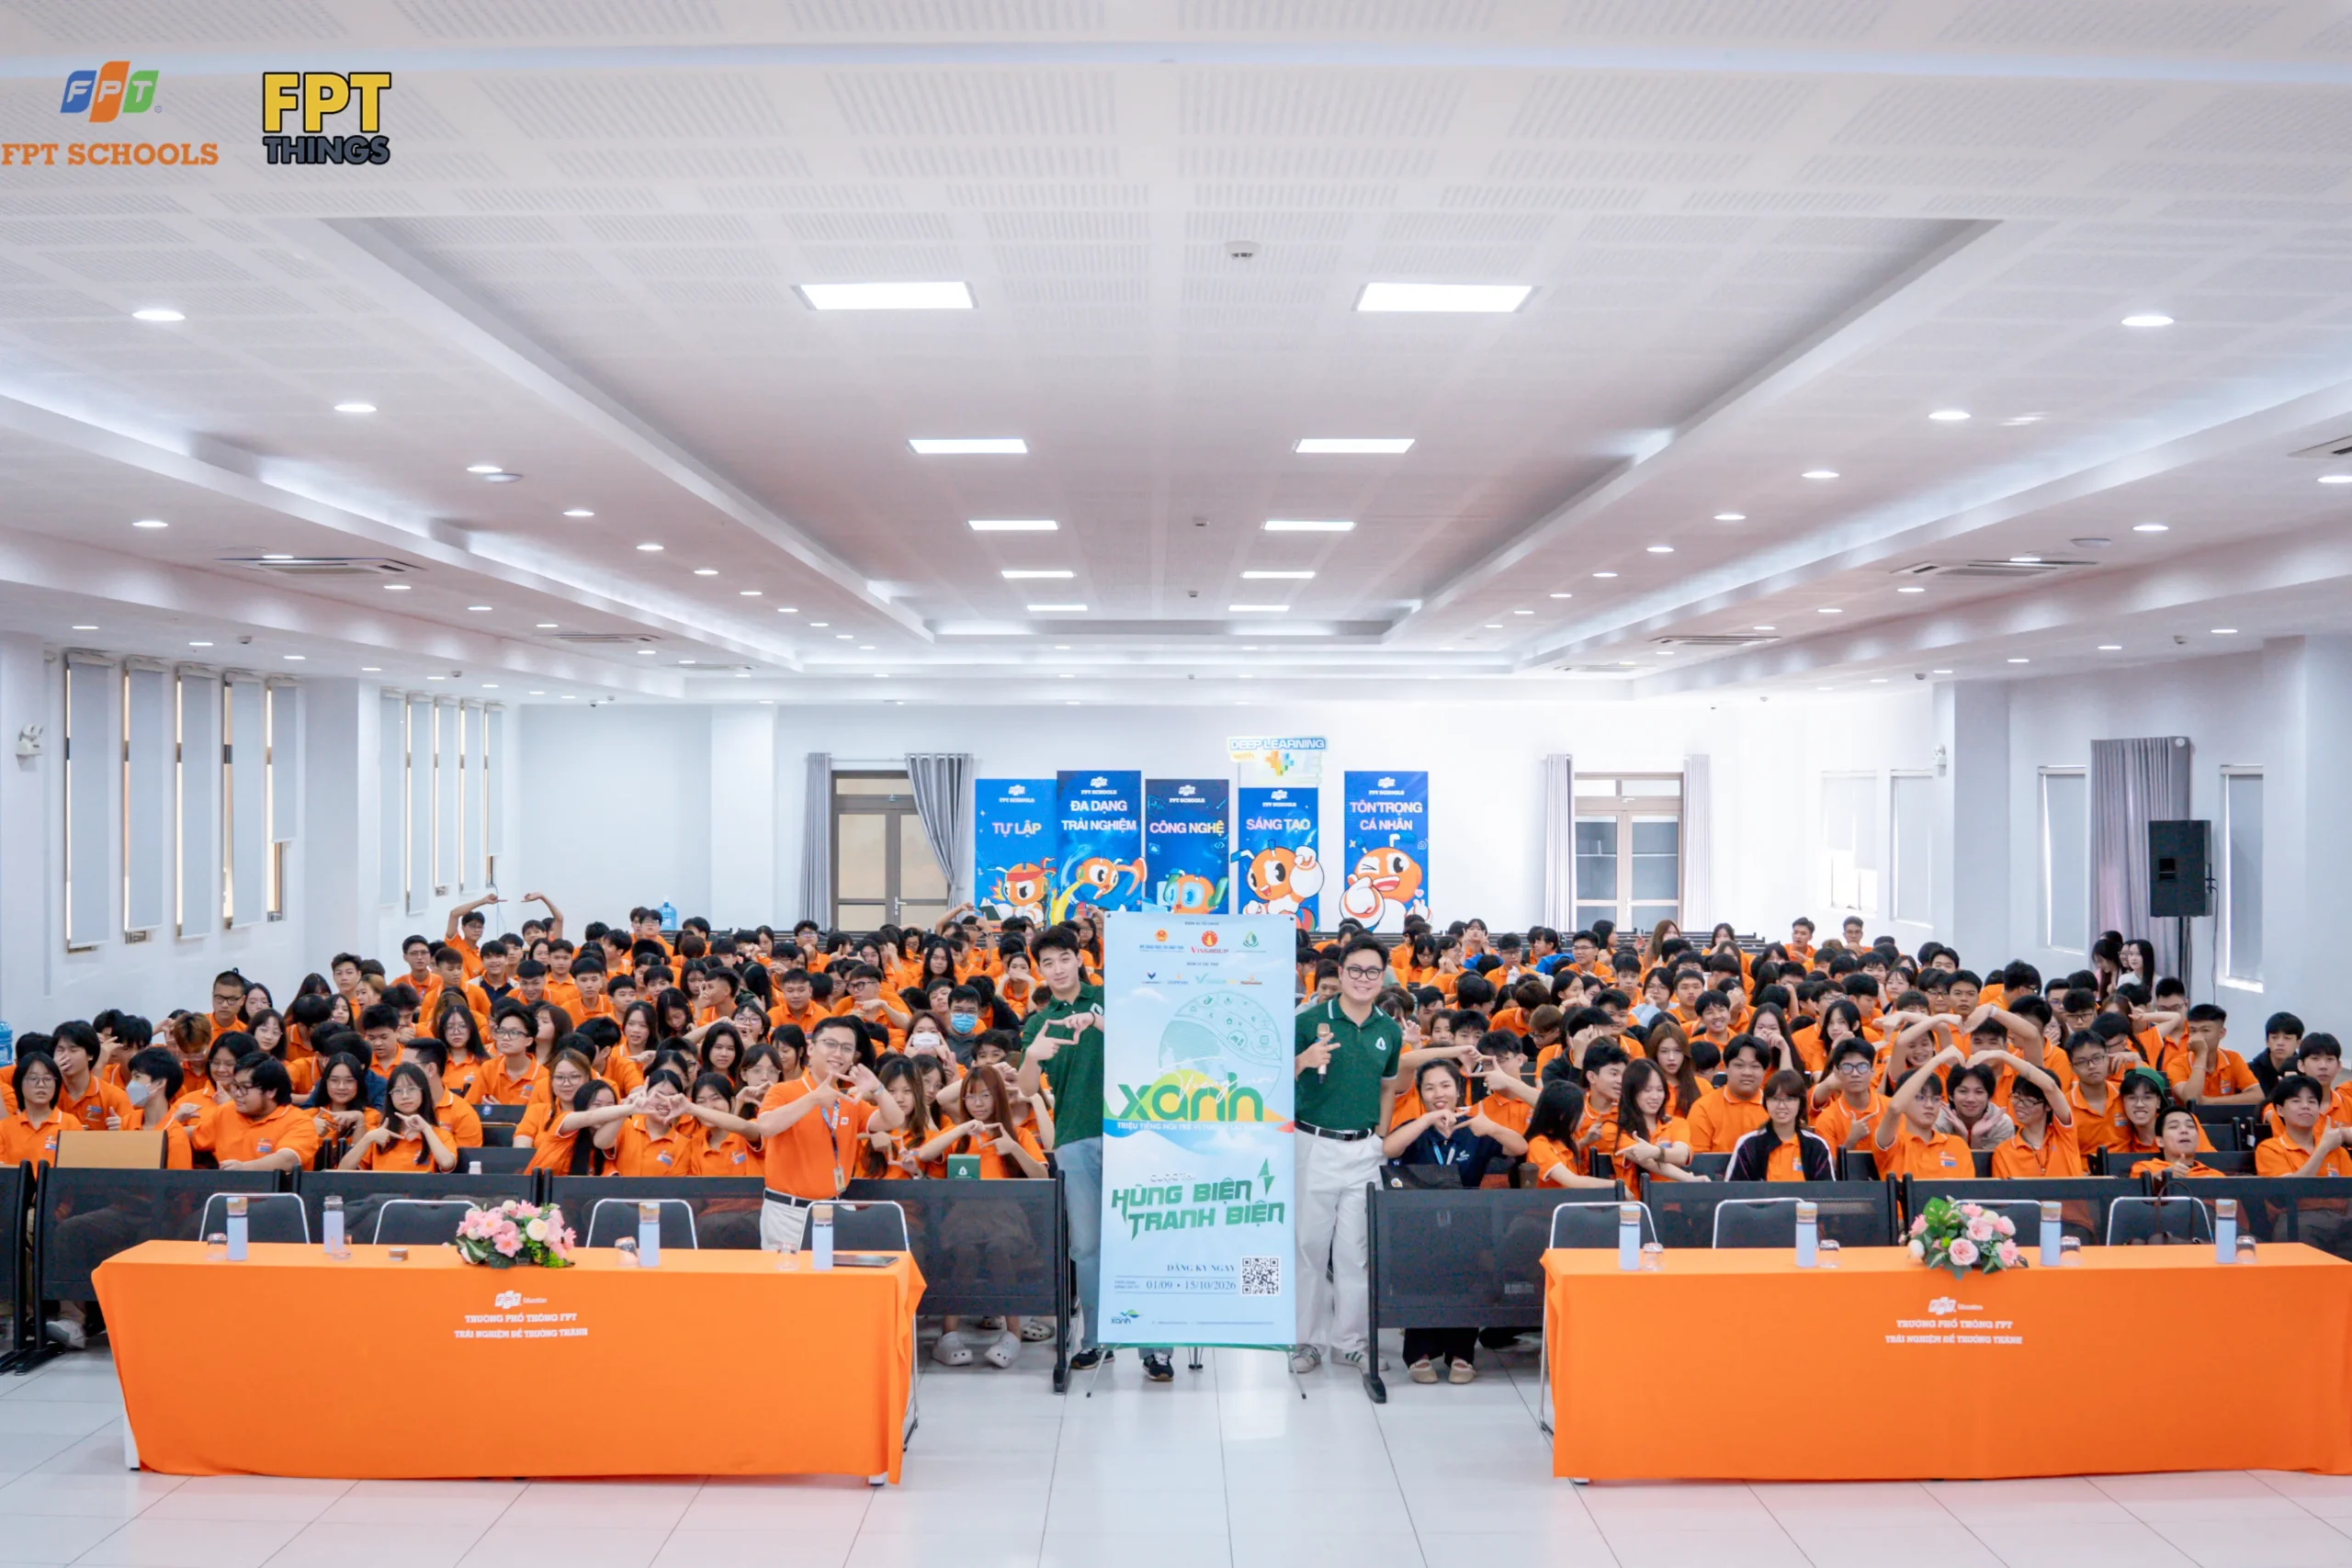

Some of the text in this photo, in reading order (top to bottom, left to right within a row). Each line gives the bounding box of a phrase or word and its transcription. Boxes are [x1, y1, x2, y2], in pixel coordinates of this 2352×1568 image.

[1231, 738, 1326, 750] DEEP LEARNING
[1070, 800, 1128, 815] ĐA DẠNG
[1350, 798, 1423, 817] TÔN TRỌNG
[992, 819, 1043, 838] TỰ LẬP
[1061, 817, 1137, 834] TRẢI NGHIỆM
[1149, 819, 1225, 837] CÔNG NGHỆ
[1246, 816, 1311, 833] SÁNG TẠO
[1360, 817, 1413, 830] CÁ NHÂN
[1193, 1177, 1252, 1204] BIỆN
[1128, 1200, 1284, 1241] TRANH BIỆN
[1146, 1280, 1237, 1291] 01/09 15/10/2026
[560, 1313, 578, 1321] FPT
[1995, 1320, 2013, 1329] FPT
